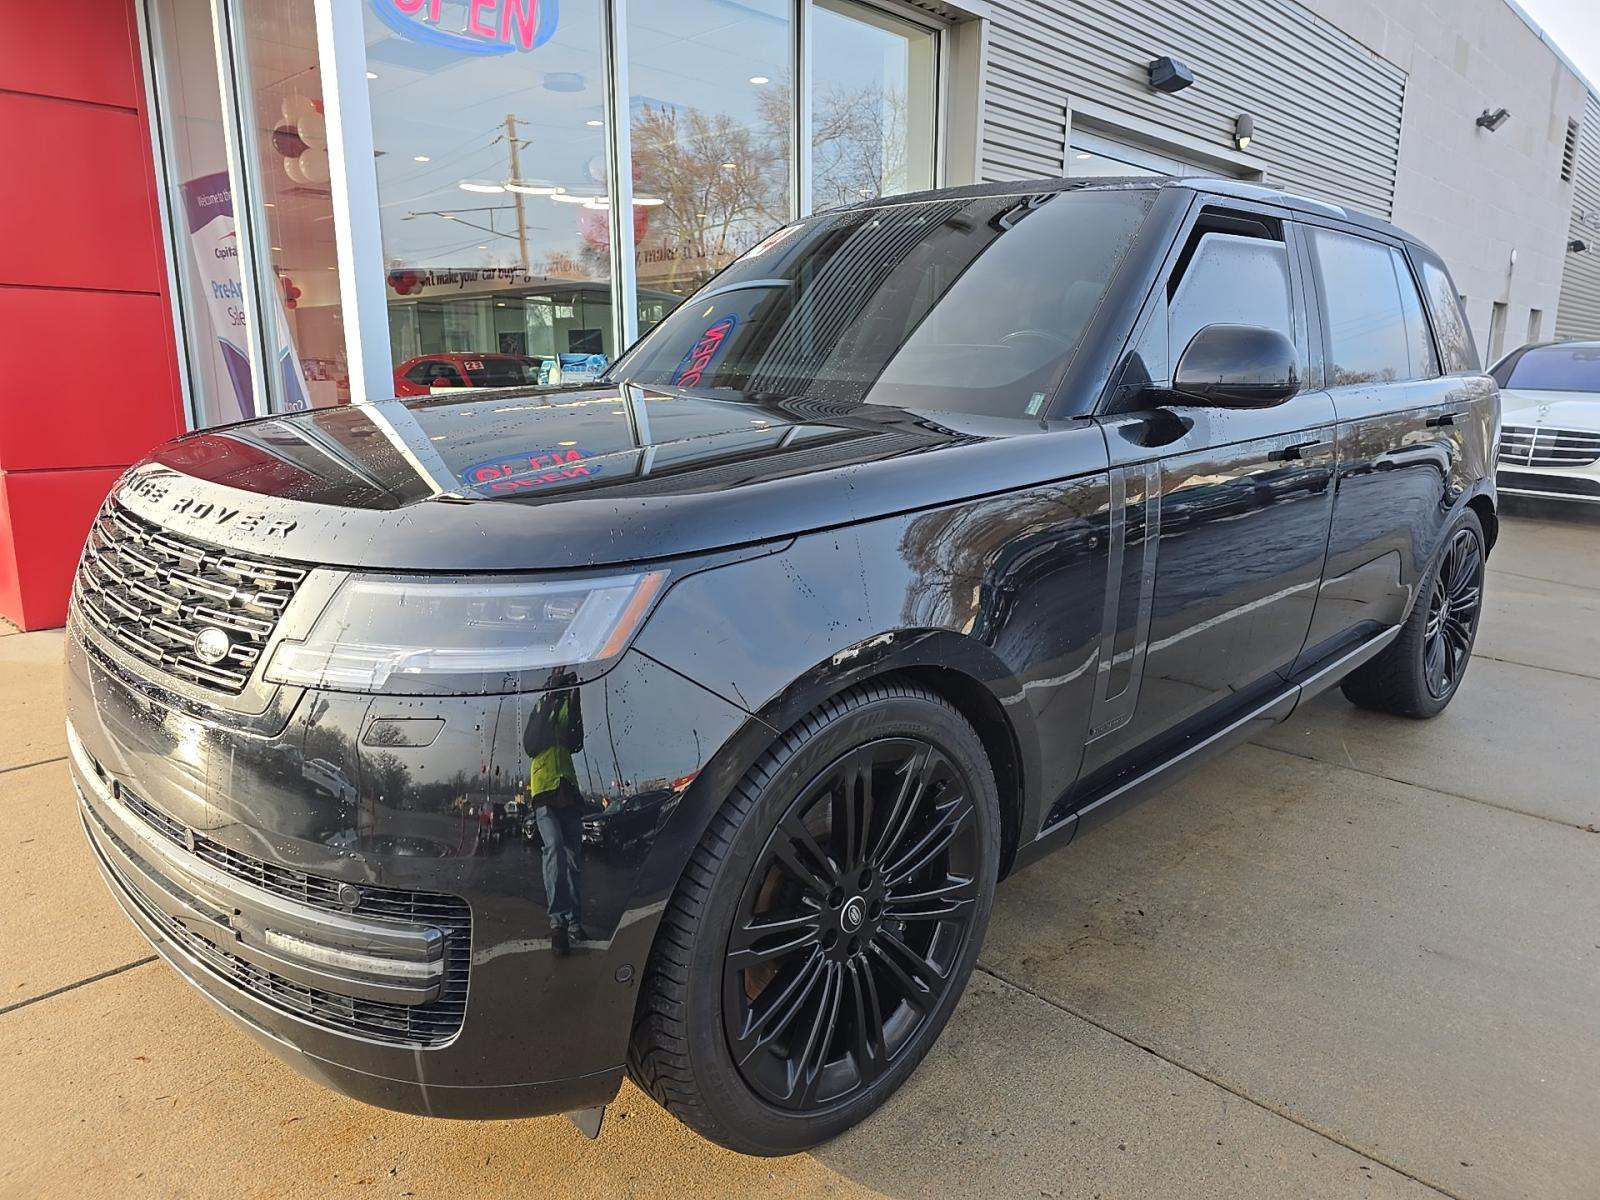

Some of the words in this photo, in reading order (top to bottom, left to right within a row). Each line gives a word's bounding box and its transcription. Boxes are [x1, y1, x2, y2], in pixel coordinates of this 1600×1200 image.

[394, 0, 536, 49] EN
[215, 246, 237, 260] Capita
[171, 498, 298, 539] ROVER
